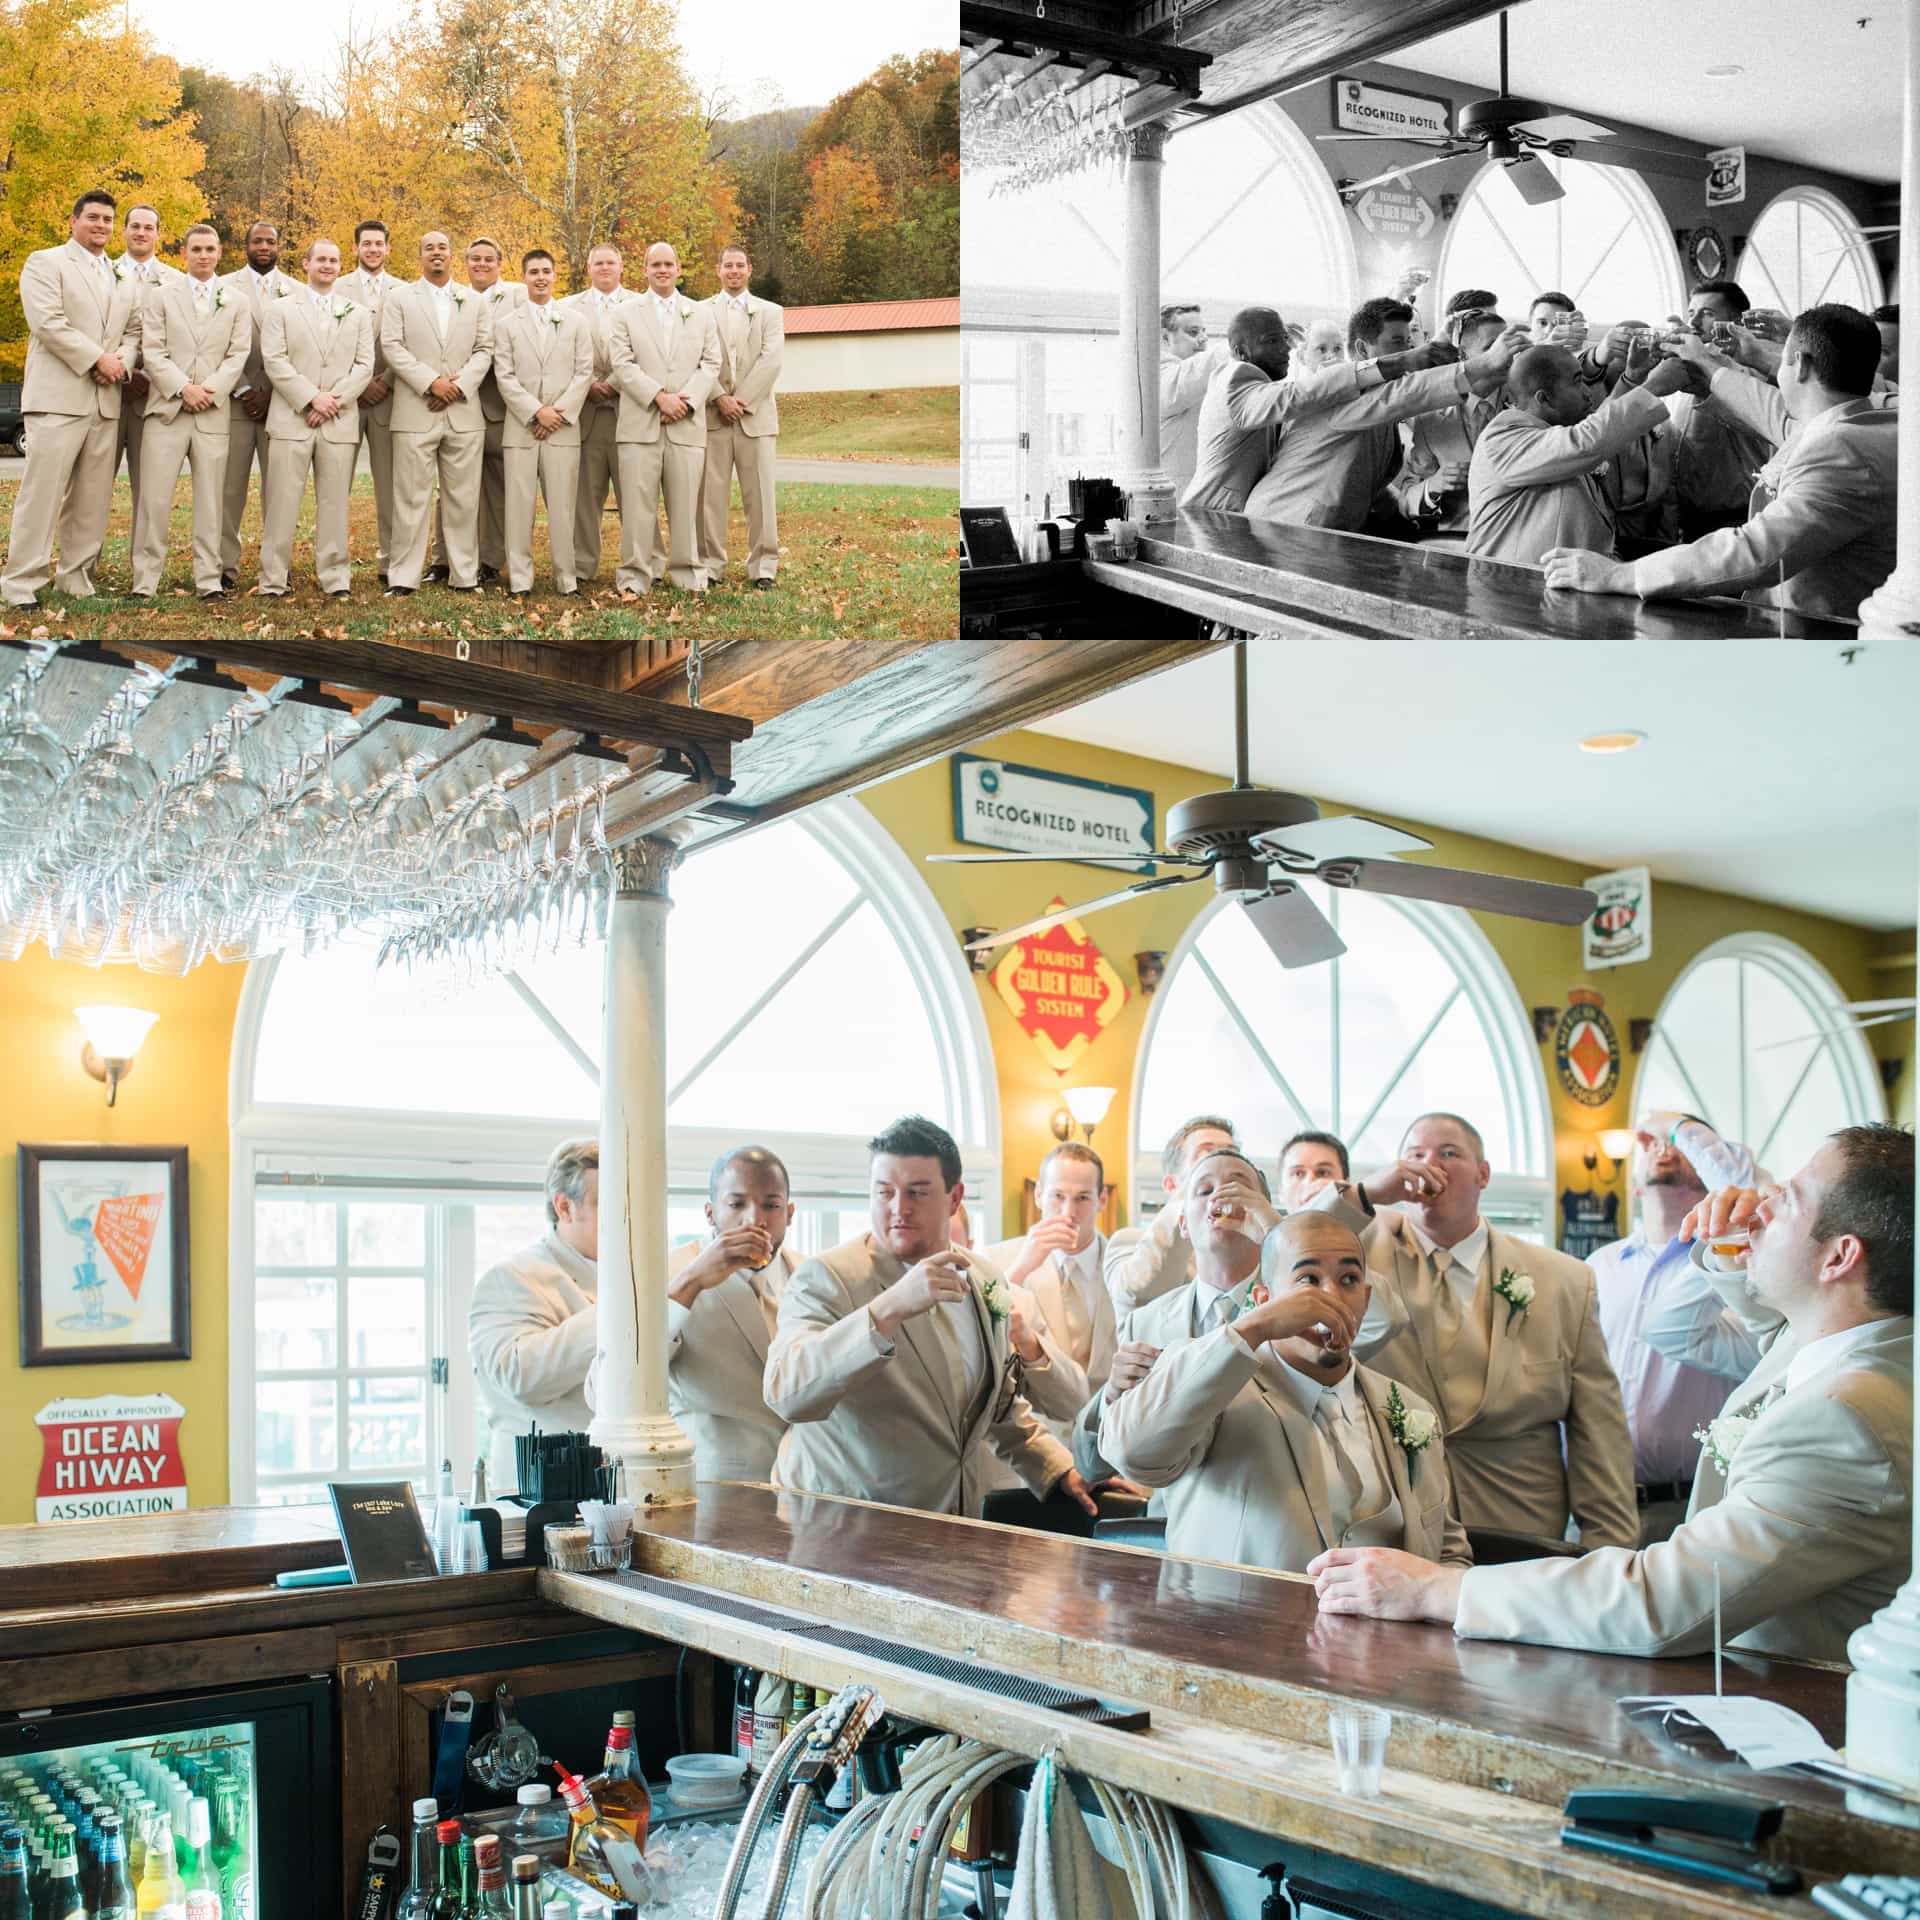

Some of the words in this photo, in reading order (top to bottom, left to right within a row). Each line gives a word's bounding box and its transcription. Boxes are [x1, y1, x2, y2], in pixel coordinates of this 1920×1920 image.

[1346, 103, 1406, 123] RECOGNIZED
[1409, 116, 1438, 130] HOTEL
[976, 800, 1076, 832] RECOGNIZED
[1083, 821, 1131, 844] HOTEL
[1033, 948, 1085, 969] TOURIST
[1017, 968, 1067, 996] GOLDEN
[1070, 974, 1104, 999] RULE
[1037, 998, 1084, 1017] SYSTEM
[47, 1408, 108, 1420] OFFICIALLY
[116, 1405, 172, 1416] APPROVED
[62, 1423, 160, 1456] OCEAN
[55, 1454, 167, 1489] HIWAY
[50, 1496, 173, 1520] ASSOCIATION
